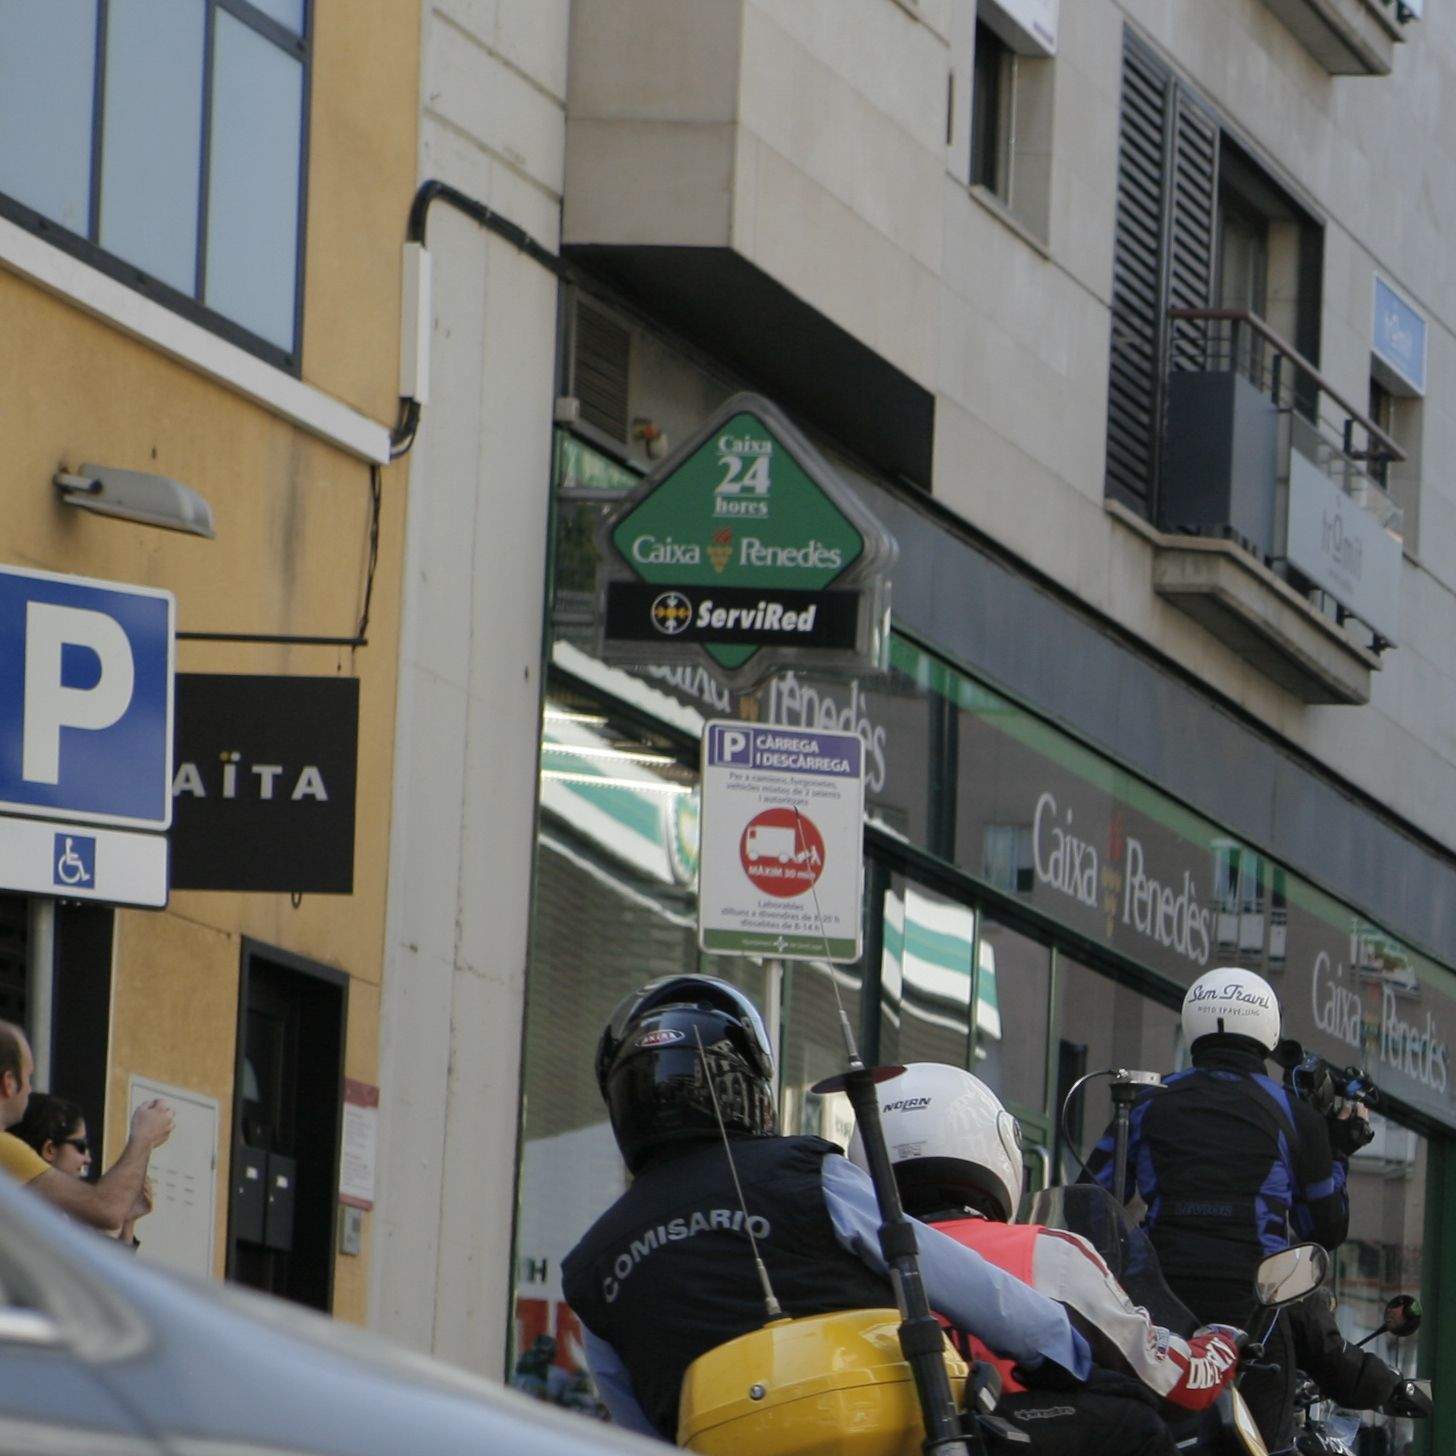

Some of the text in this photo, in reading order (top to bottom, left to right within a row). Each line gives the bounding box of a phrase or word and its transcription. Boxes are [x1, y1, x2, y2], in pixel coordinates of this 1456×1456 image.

[718, 436, 772, 453] Caixa
[714, 456, 771, 495] 24
[714, 497, 768, 515] hores
[632, 535, 842, 569] Caixa Penedès
[697, 600, 817, 632] ServiRed
[23, 600, 135, 785] P
[723, 731, 746, 762] P
[756, 734, 819, 755] CÀRREGA
[762, 753, 850, 773] DESCÀRREGA
[1033, 792, 1210, 966] Caixa Penedès
[1312, 951, 1447, 1095] Caixa Penedès
[883, 1098, 932, 1113] NOLAN
[603, 1209, 771, 1303] COMISARIO
